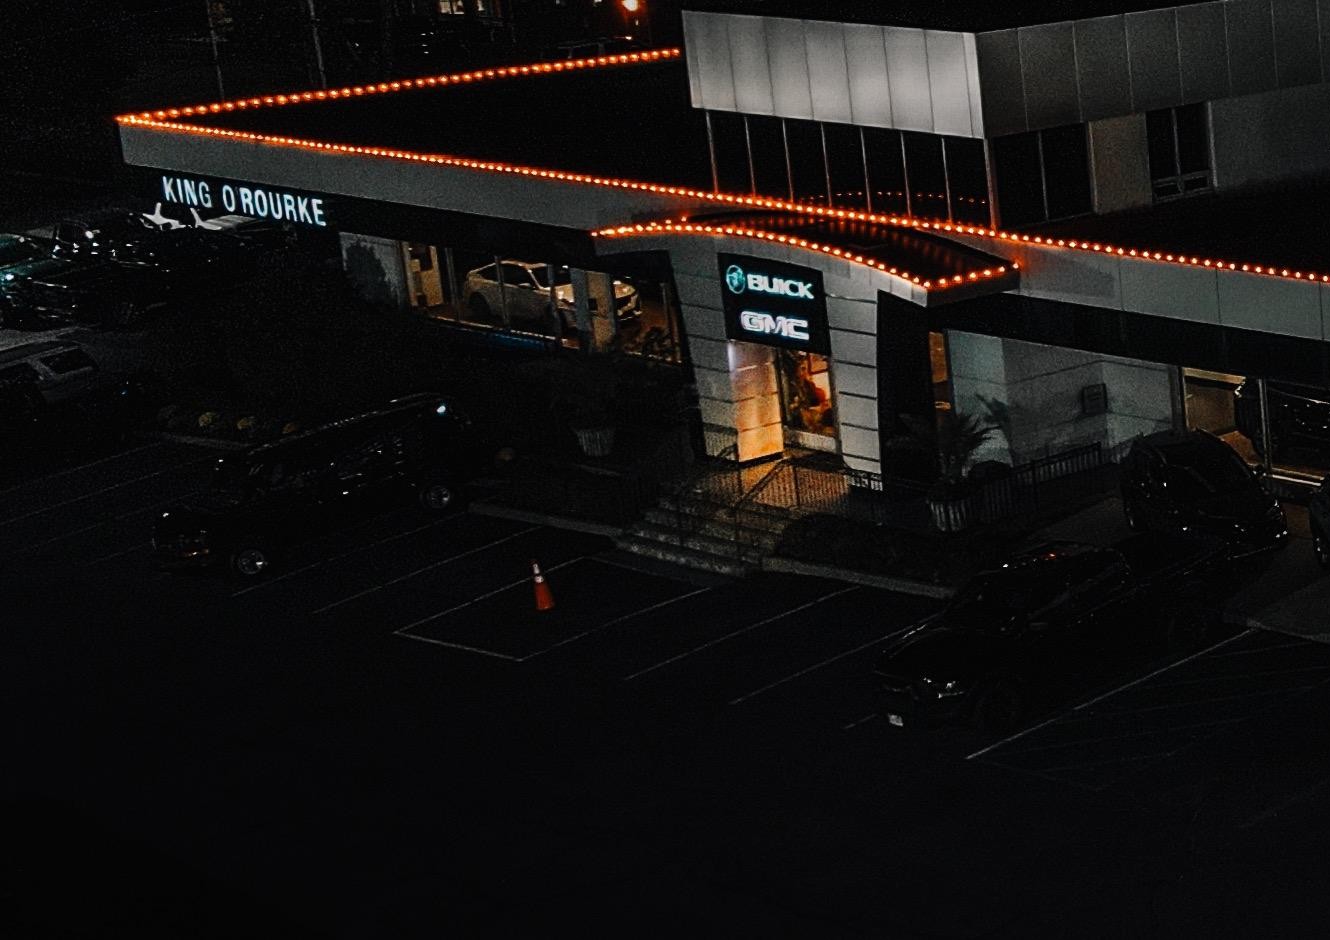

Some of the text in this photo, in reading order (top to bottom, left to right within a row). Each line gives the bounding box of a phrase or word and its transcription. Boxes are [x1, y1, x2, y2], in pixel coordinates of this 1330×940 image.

[162, 175, 327, 227] KING O'ROURKE
[747, 273, 815, 300] BUICK
[740, 311, 810, 341] GMC
